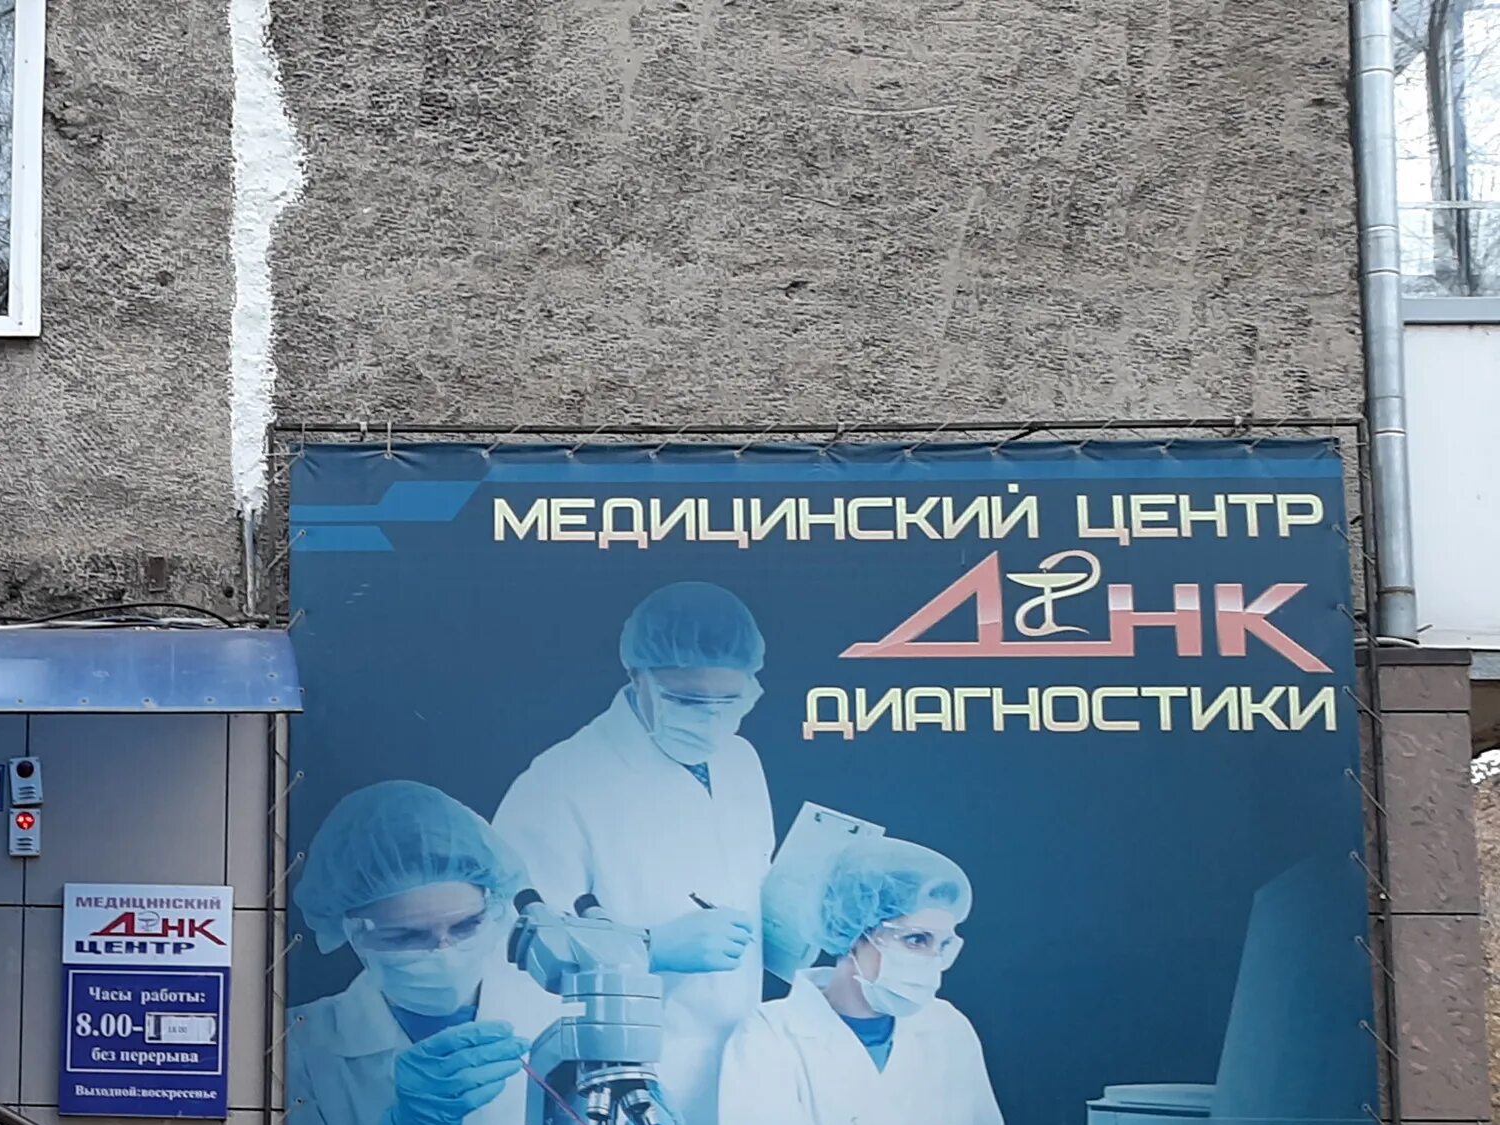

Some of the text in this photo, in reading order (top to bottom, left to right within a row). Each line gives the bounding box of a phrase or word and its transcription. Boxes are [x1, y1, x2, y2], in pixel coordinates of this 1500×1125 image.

[494, 484, 1324, 549] МЕДИЦИНСКИЙ ЦЕНТР
[839, 552, 1333, 673] ДНК
[804, 687, 1336, 739] ДИАГНОСТИКИ
[76, 896, 221, 909] МЕДИЦИНСКИЙ
[89, 911, 227, 945] ДНК
[75, 941, 195, 954] ЦЕНТР
[89, 987, 206, 1004] Часы работы:
[92, 1048, 198, 1065] без перерыва
